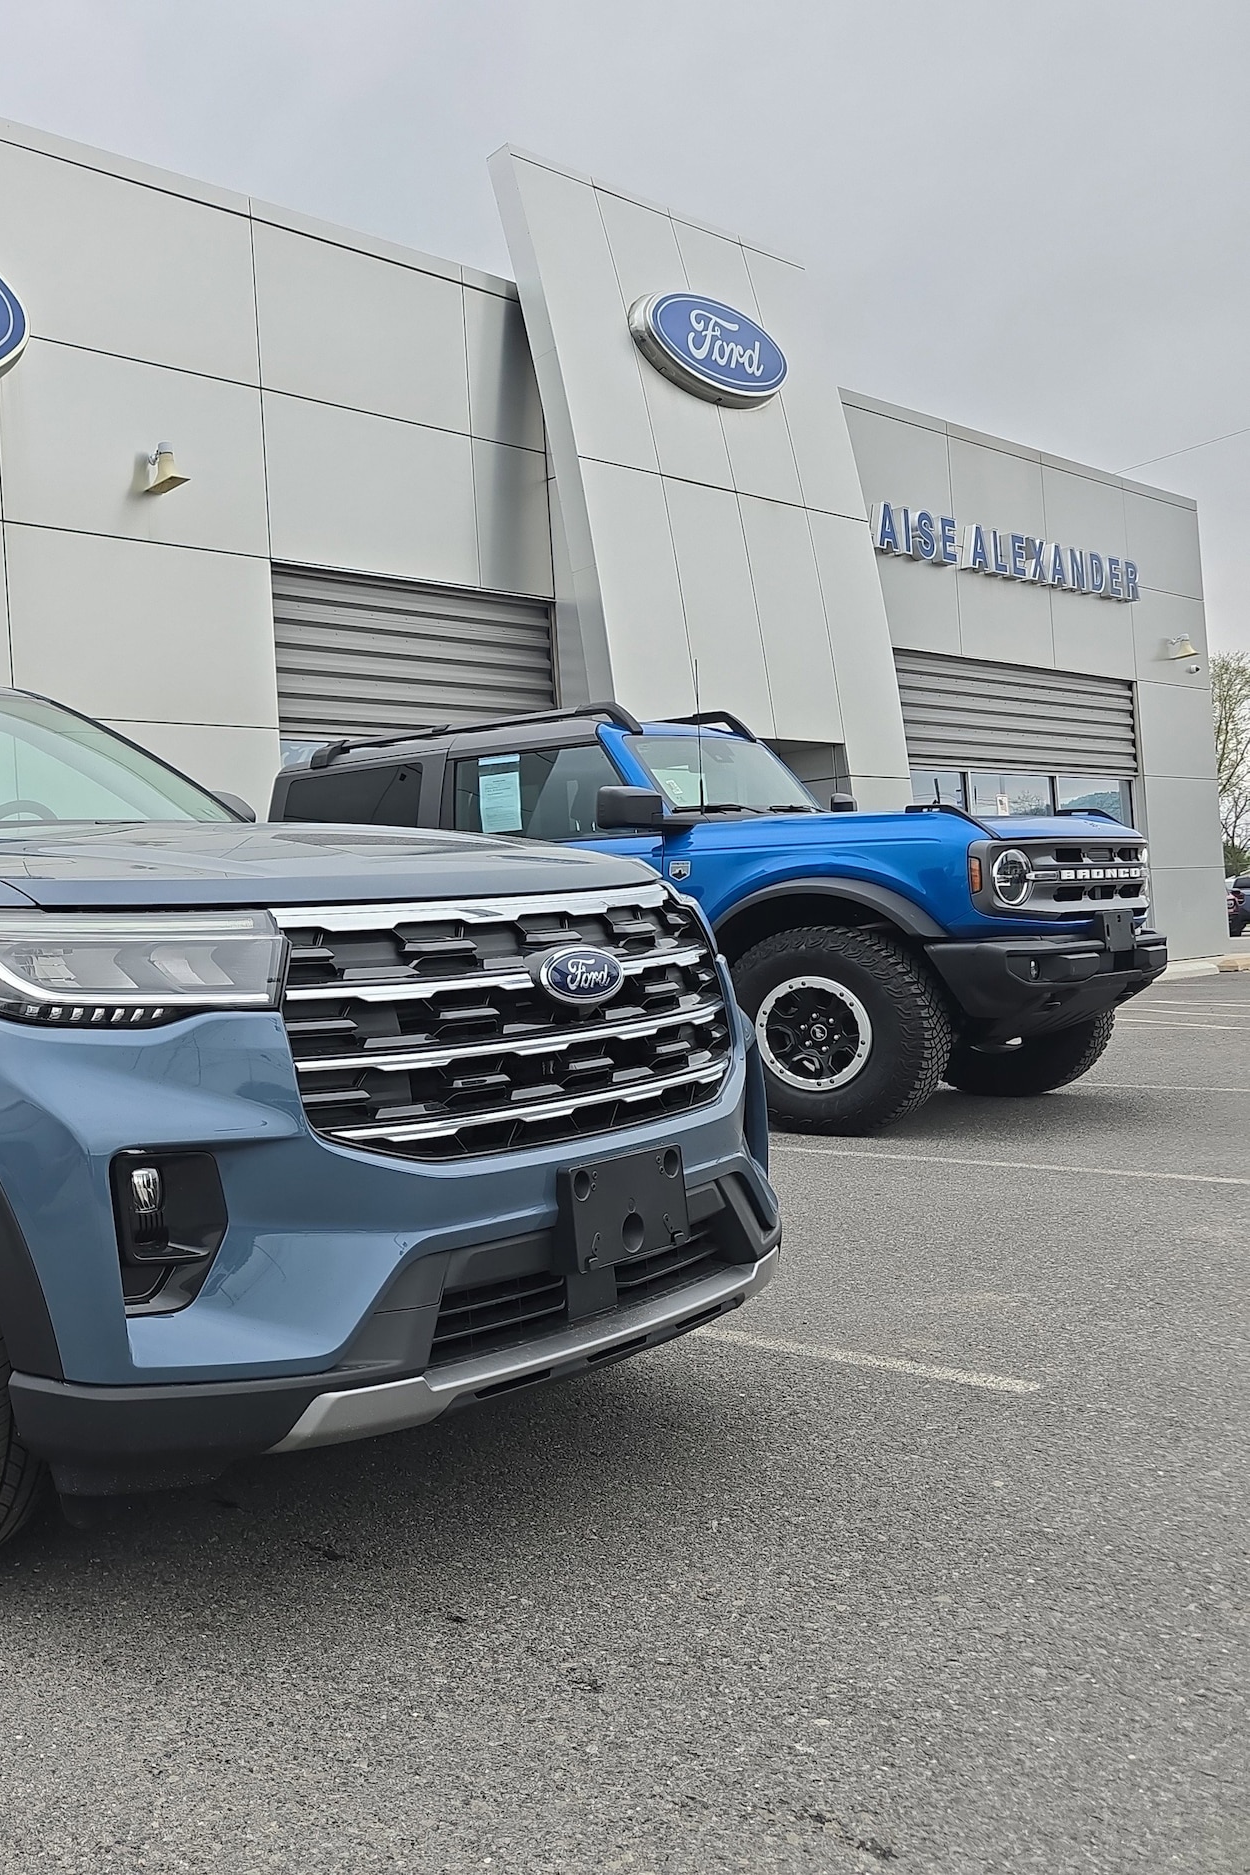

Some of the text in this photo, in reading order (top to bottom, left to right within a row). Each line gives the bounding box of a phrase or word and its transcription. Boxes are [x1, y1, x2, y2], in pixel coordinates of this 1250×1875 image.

[687, 309, 764, 377] Ford
[964, 522, 1142, 602] ALEXANDER
[1060, 867, 1141, 880] BRONCO
[567, 958, 610, 990] Ford
